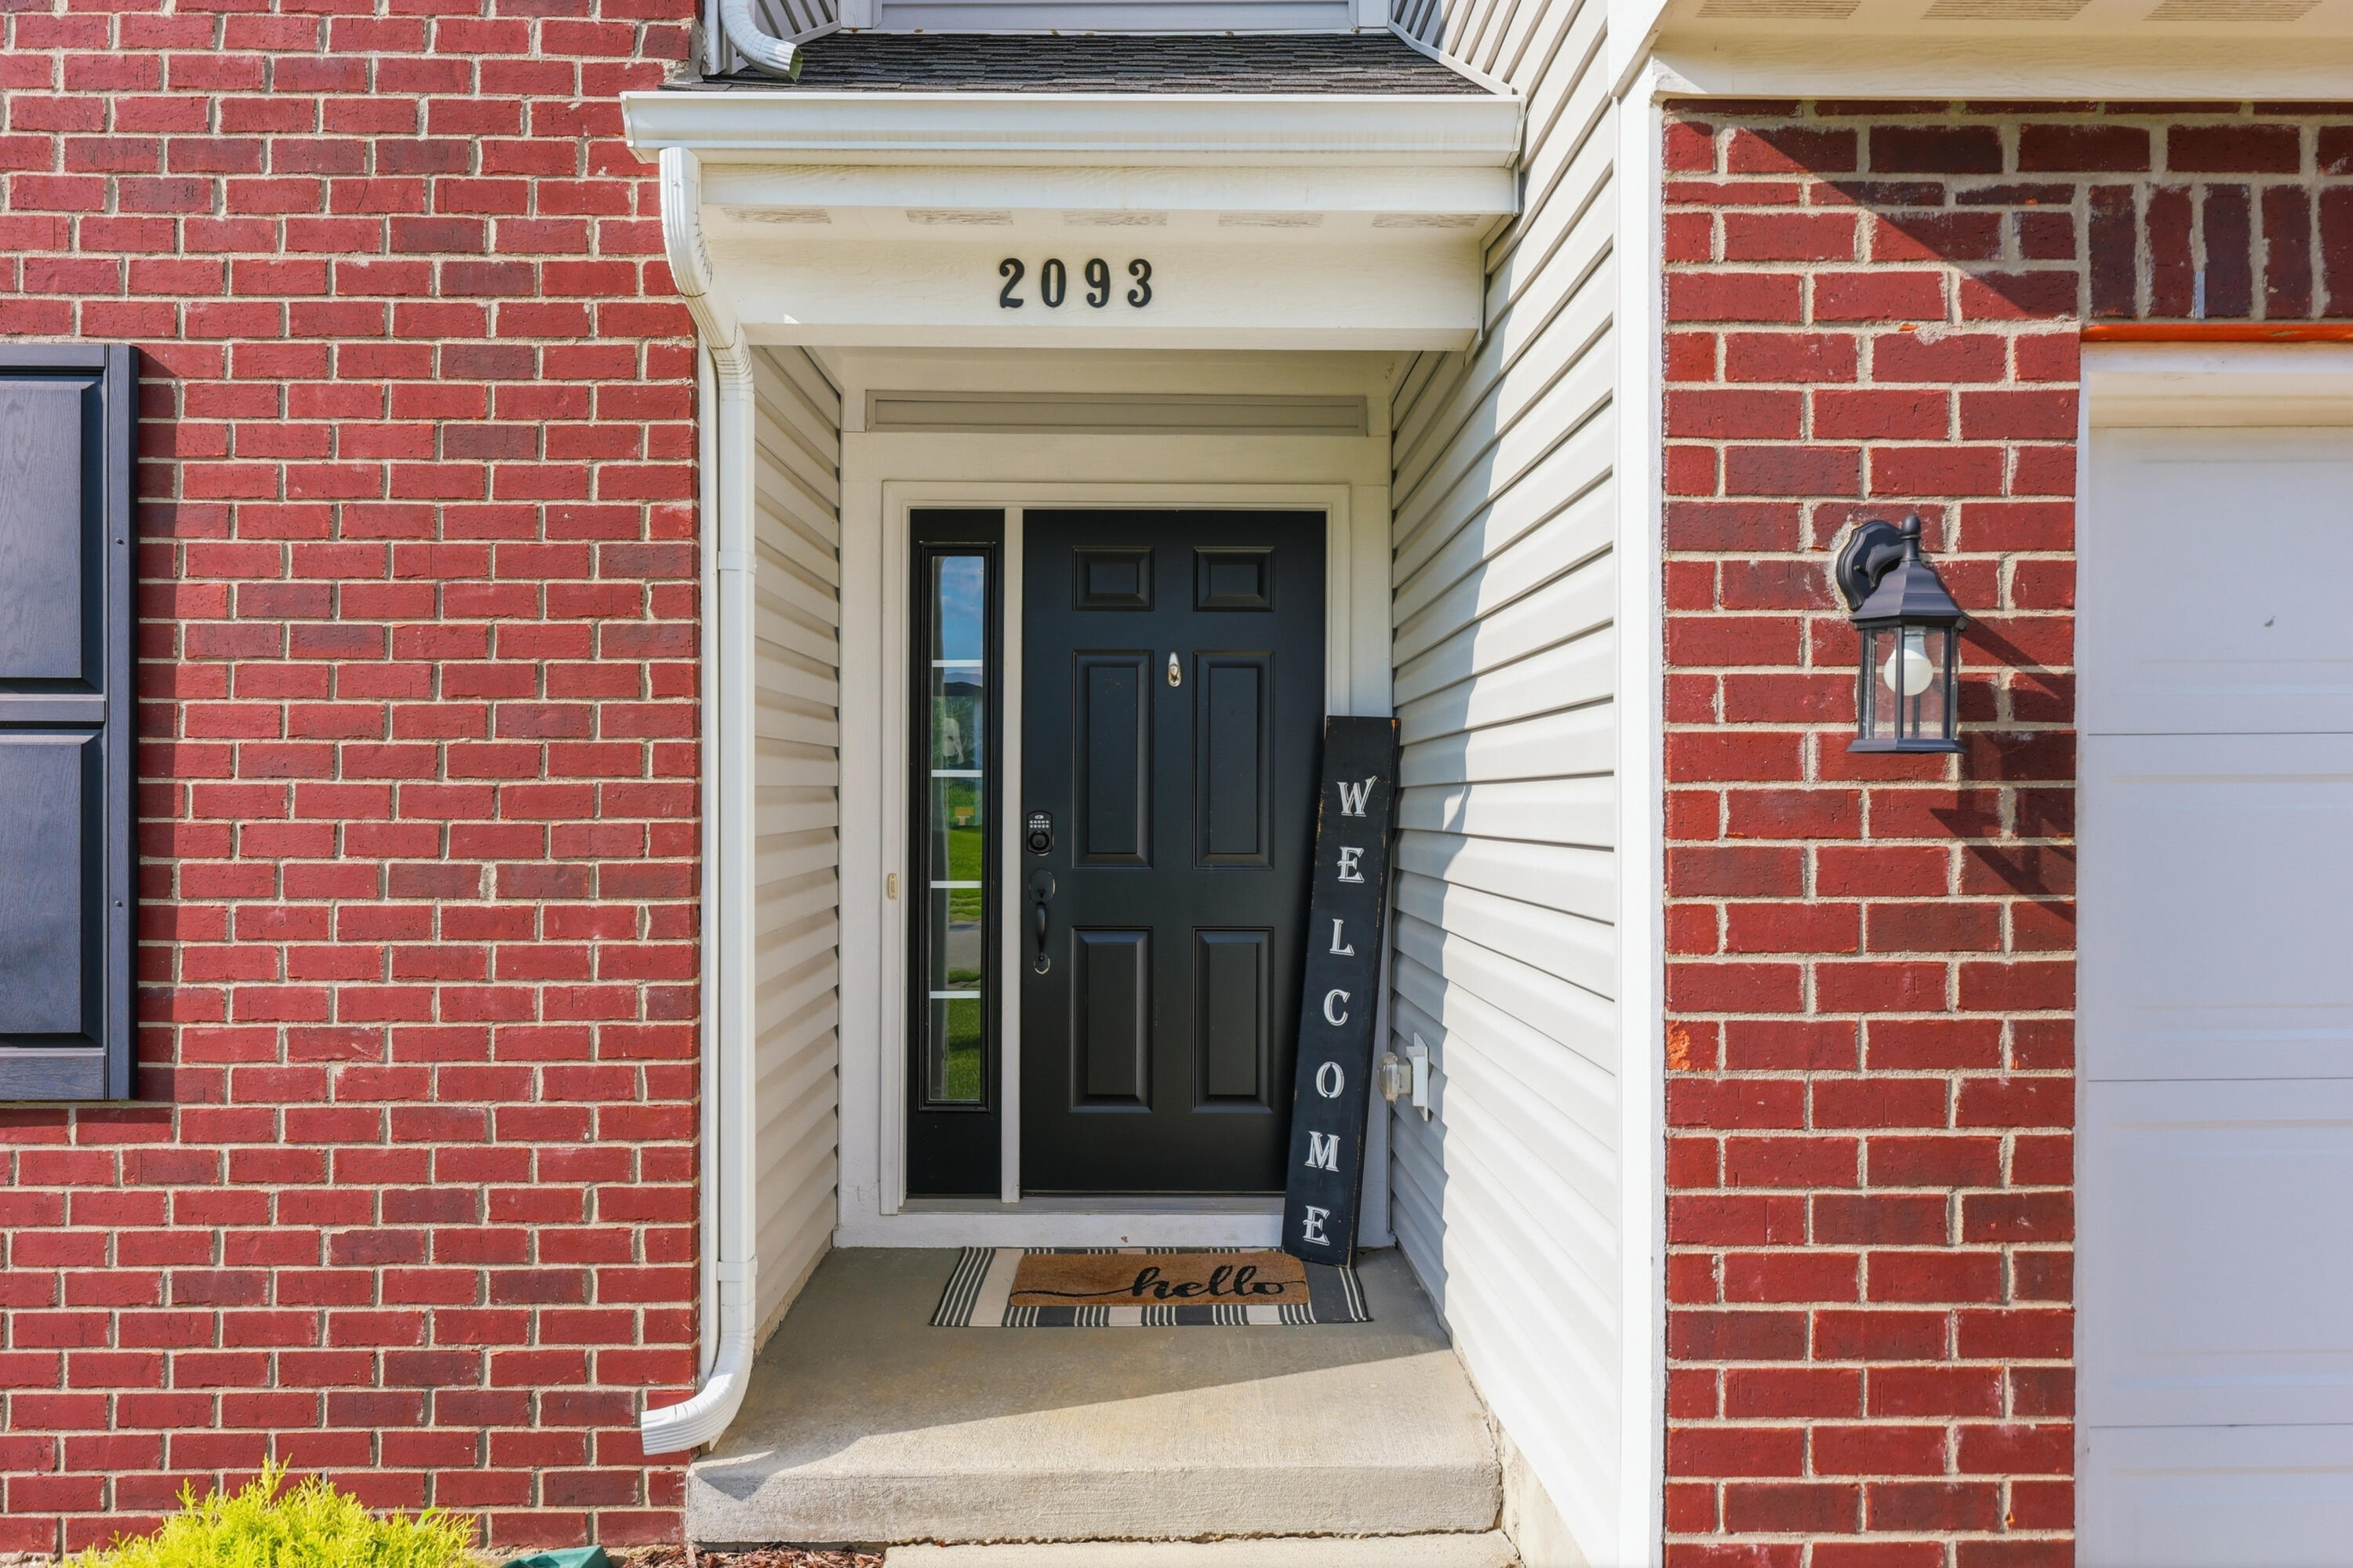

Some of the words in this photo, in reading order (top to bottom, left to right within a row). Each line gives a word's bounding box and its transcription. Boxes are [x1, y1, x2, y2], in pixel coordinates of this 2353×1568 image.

[999, 258, 1151, 308] 2093
[1303, 775, 1378, 1246] WELCOME
[1118, 1266, 1305, 1299] hello
